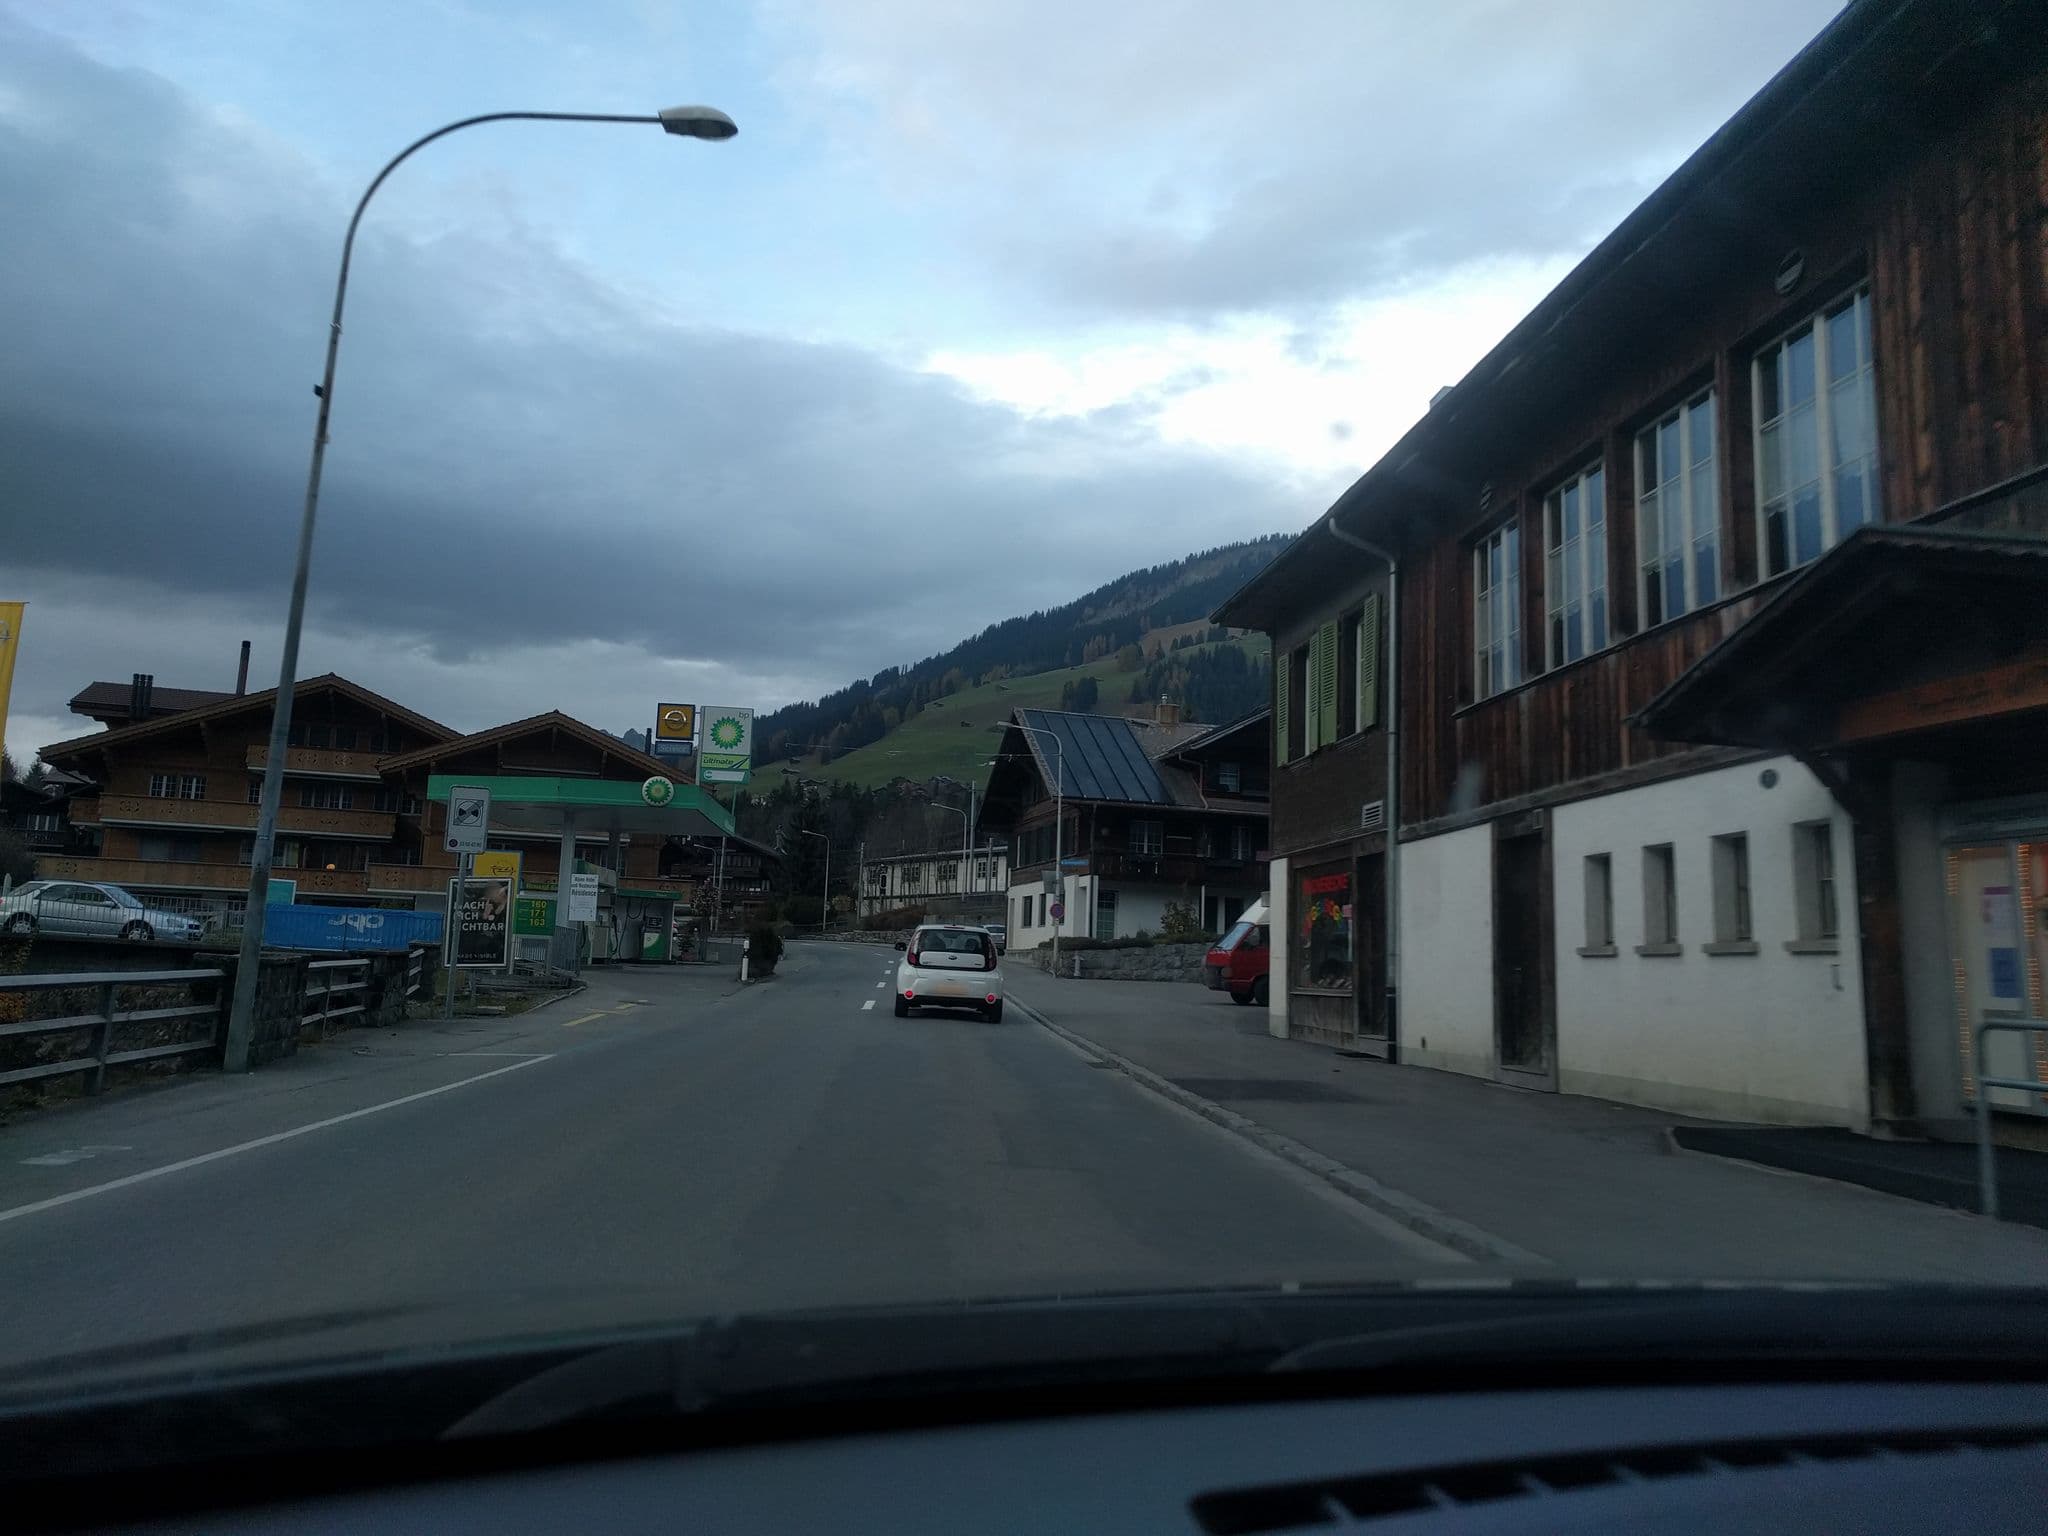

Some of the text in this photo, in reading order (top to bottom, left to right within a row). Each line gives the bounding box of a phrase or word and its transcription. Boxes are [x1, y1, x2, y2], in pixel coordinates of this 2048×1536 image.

[738, 711, 750, 720] bp
[530, 909, 546, 917] 171
[529, 918, 546, 927] 163
